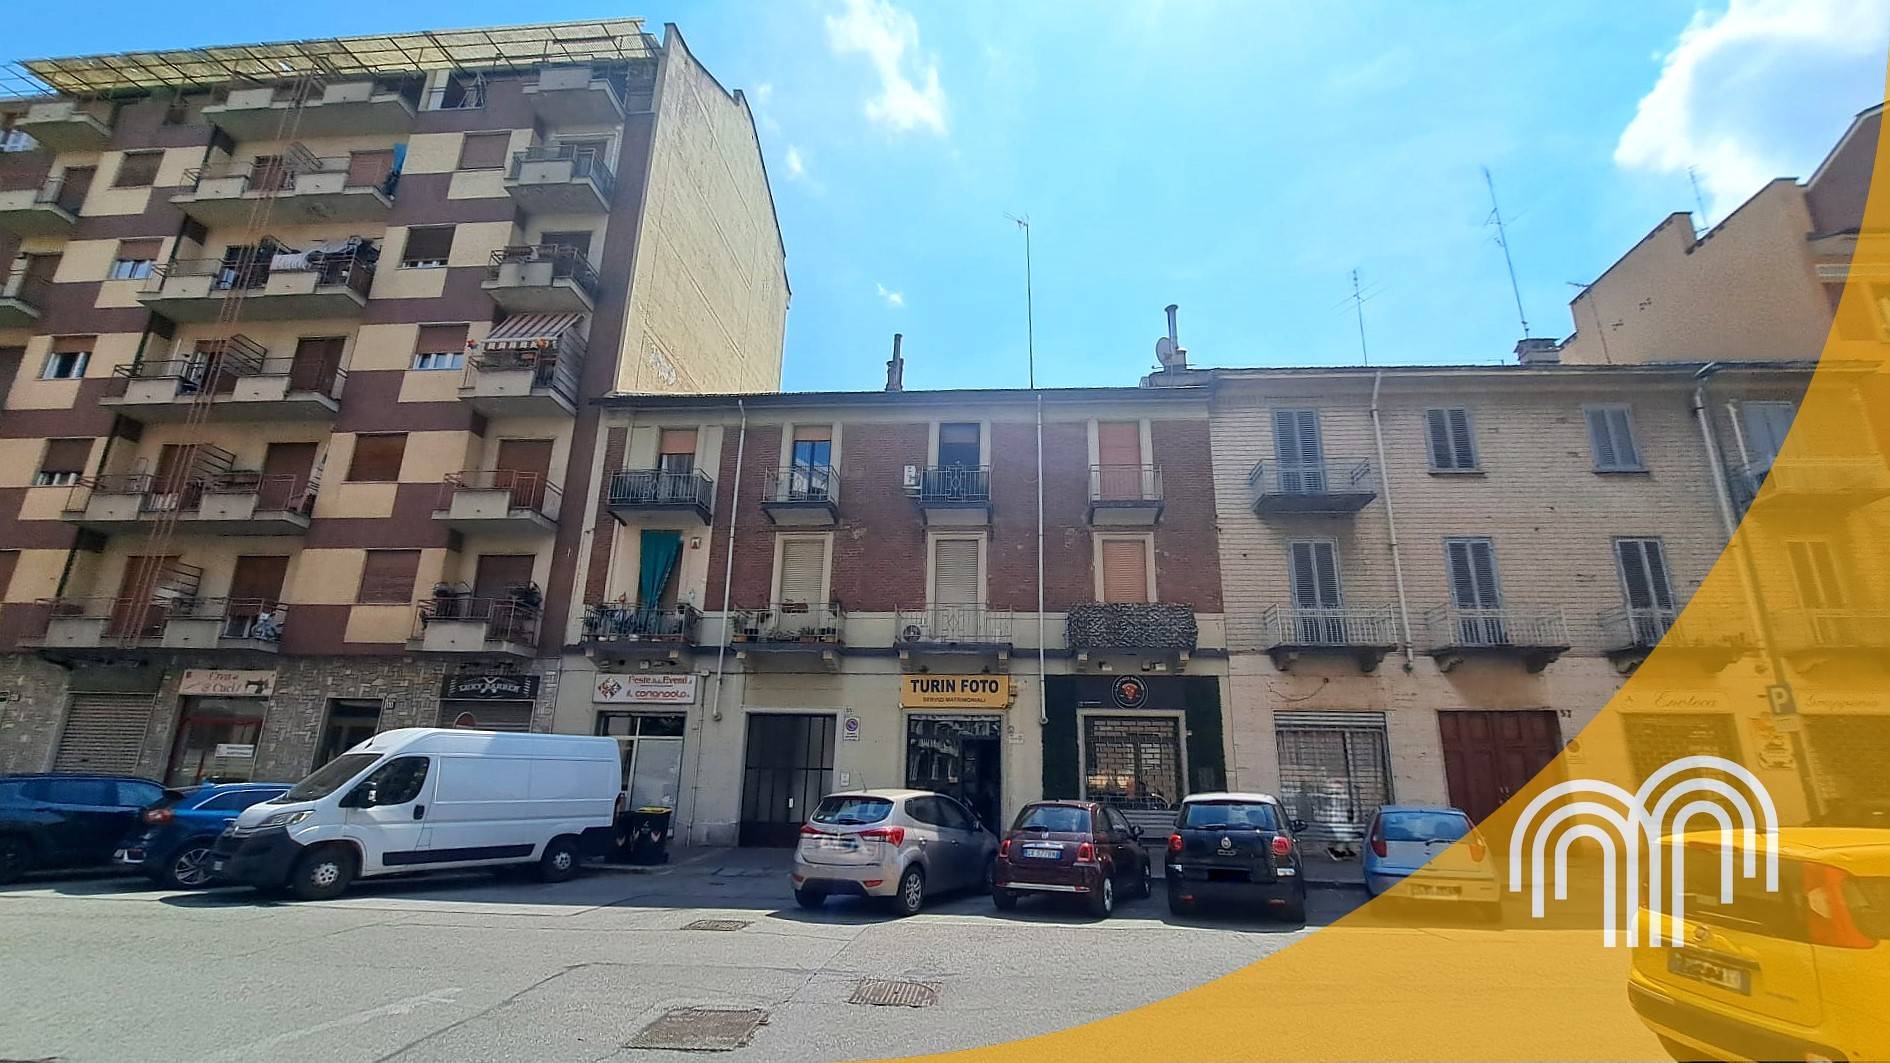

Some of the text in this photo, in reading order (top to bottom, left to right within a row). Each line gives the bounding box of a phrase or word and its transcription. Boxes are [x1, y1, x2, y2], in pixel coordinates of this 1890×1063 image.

[910, 679, 999, 693] TURIN FOTO
[1771, 687, 1789, 712] P
